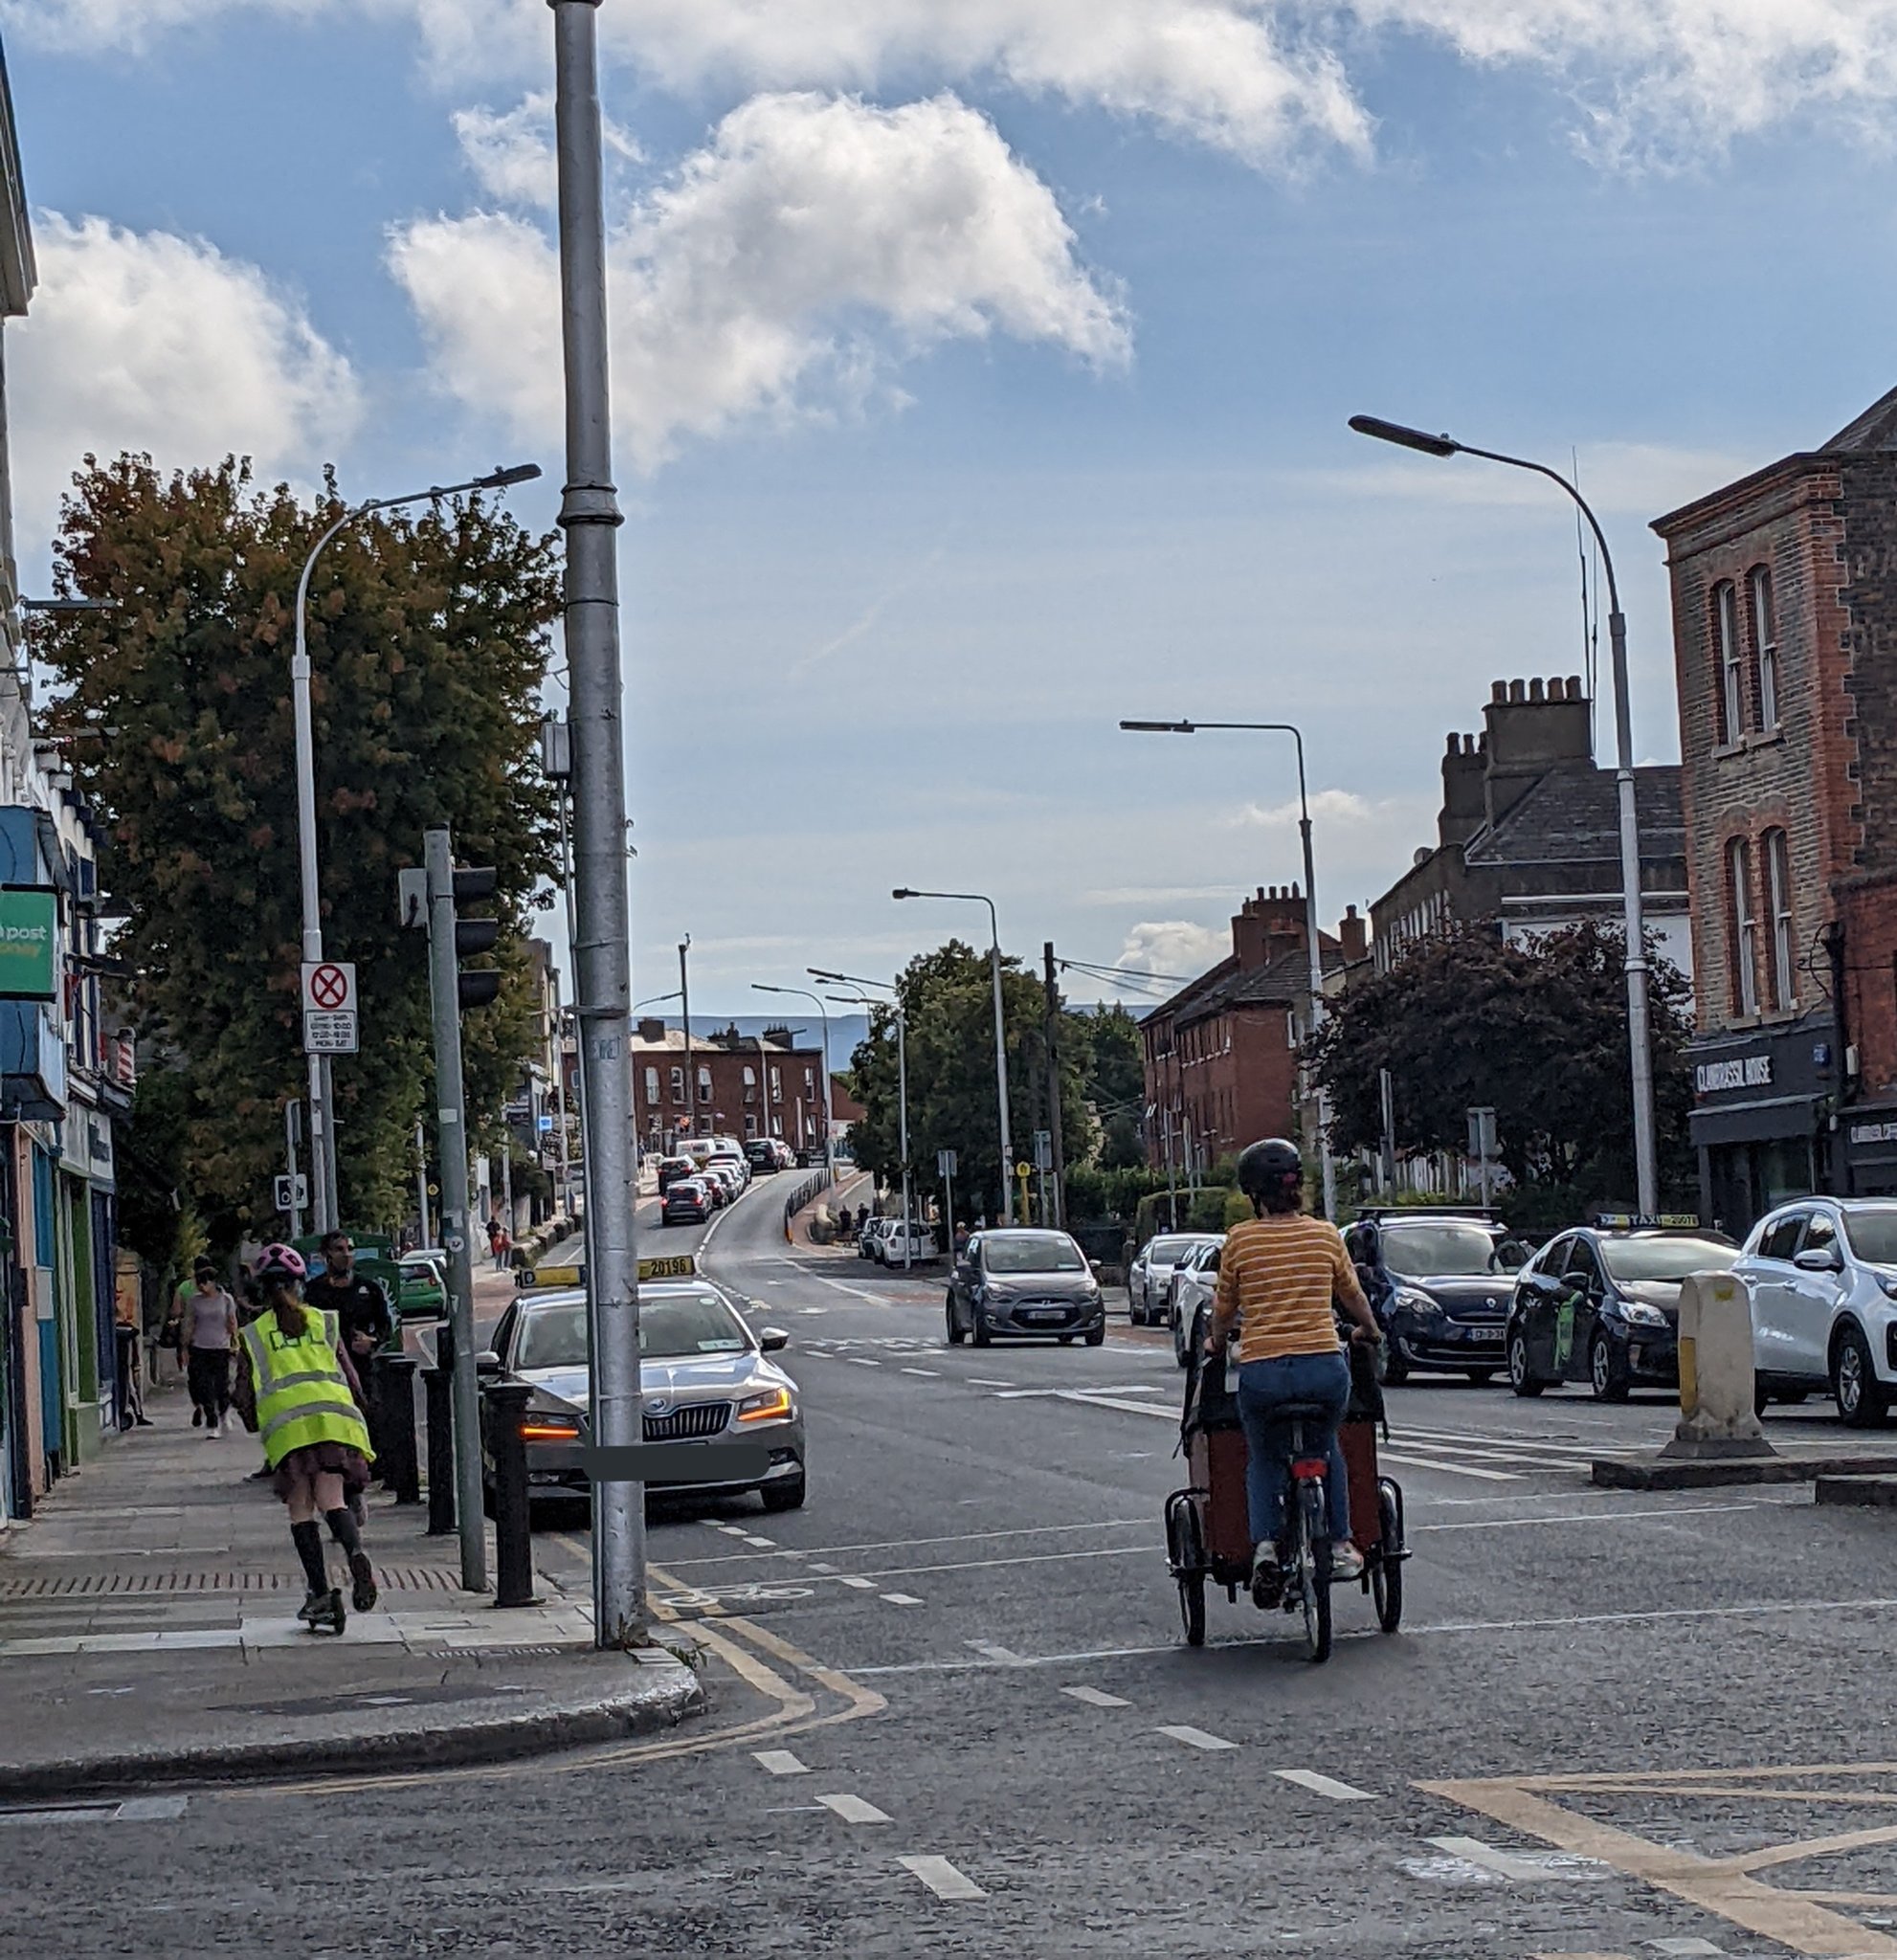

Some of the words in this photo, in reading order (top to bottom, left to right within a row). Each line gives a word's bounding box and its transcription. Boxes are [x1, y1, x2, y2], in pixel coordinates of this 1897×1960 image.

[6, 925, 47, 941] post
[1631, 1214, 1662, 1226] TAXI
[651, 1258, 687, 1276] 20196
